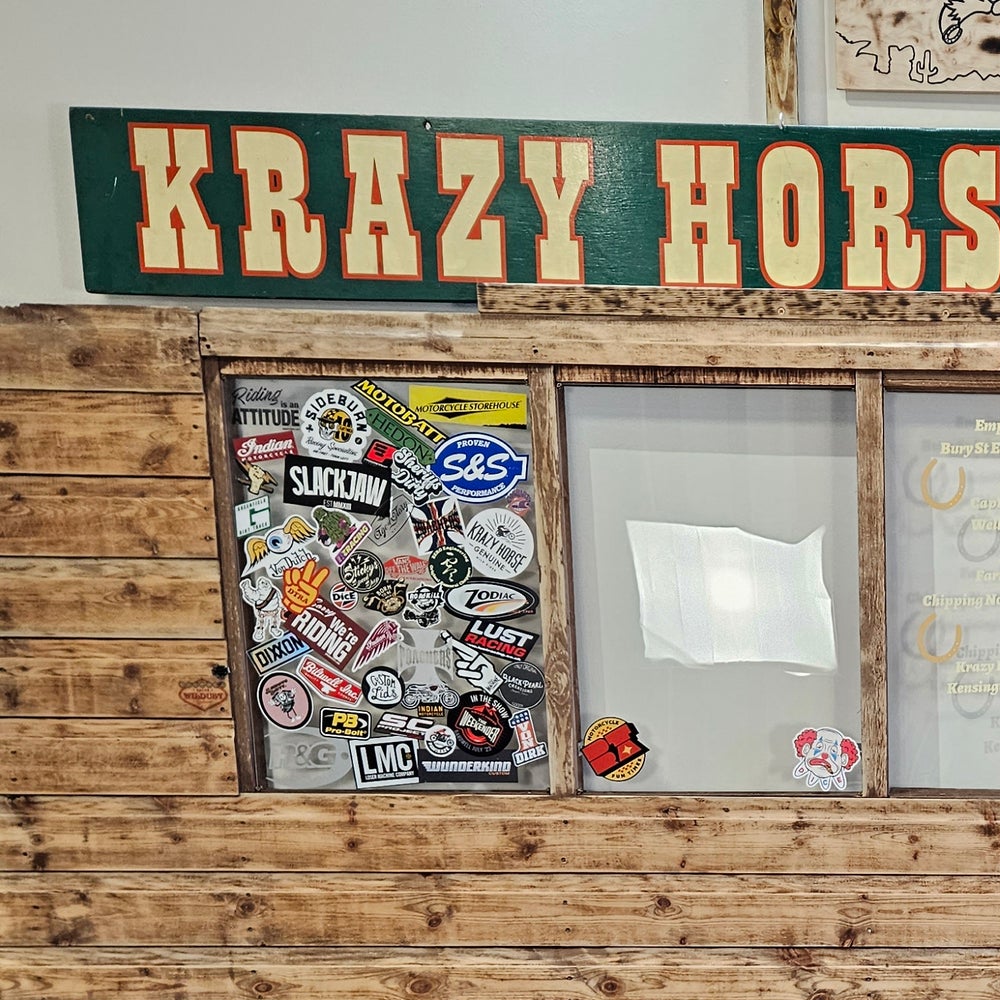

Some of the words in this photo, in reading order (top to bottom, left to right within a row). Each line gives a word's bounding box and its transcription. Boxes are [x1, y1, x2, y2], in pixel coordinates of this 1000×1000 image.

[128, 122, 594, 283] KRAZY
[232, 386, 283, 405] Riding
[415, 403, 468, 413] MOTORCYCLE
[469, 400, 521, 410] STOREHOUSE
[233, 408, 300, 426] ATTITUDE
[305, 393, 368, 432] SIDEBURN
[357, 379, 447, 444] MOTOBATT
[237, 439, 294, 457] Indian
[372, 413, 430, 461] HEDON
[457, 440, 490, 449] PROVEN
[940, 442, 974, 458] Bury
[974, 441, 990, 455] St
[440, 453, 510, 481] S&S
[289, 465, 388, 507] SLACKJAW
[452, 482, 506, 497] PERFORMANCE
[467, 521, 500, 550] KRAZY
[496, 543, 527, 573] HORSE
[474, 545, 505, 571] GENUINE
[464, 589, 516, 609] ZODIAC
[922, 594, 983, 610] Chipping
[290, 609, 353, 663] RIDING
[329, 616, 358, 645] We're
[470, 620, 534, 647] LUST
[254, 635, 305, 667] DIXXON
[464, 632, 527, 657] RACING
[954, 660, 995, 675] Krazy
[470, 694, 479, 703] IN
[479, 694, 493, 704] THE
[491, 699, 510, 719] SHOW
[331, 712, 359, 729] PB
[379, 713, 434, 731] SC
[459, 710, 501, 743] WEEKENDER
[587, 719, 620, 741] MOTORCYCLE
[360, 743, 414, 775] LMC
[421, 760, 512, 772] WUNDERKIND
[515, 744, 546, 765] DIRK
[627, 758, 642, 775] TIMES
